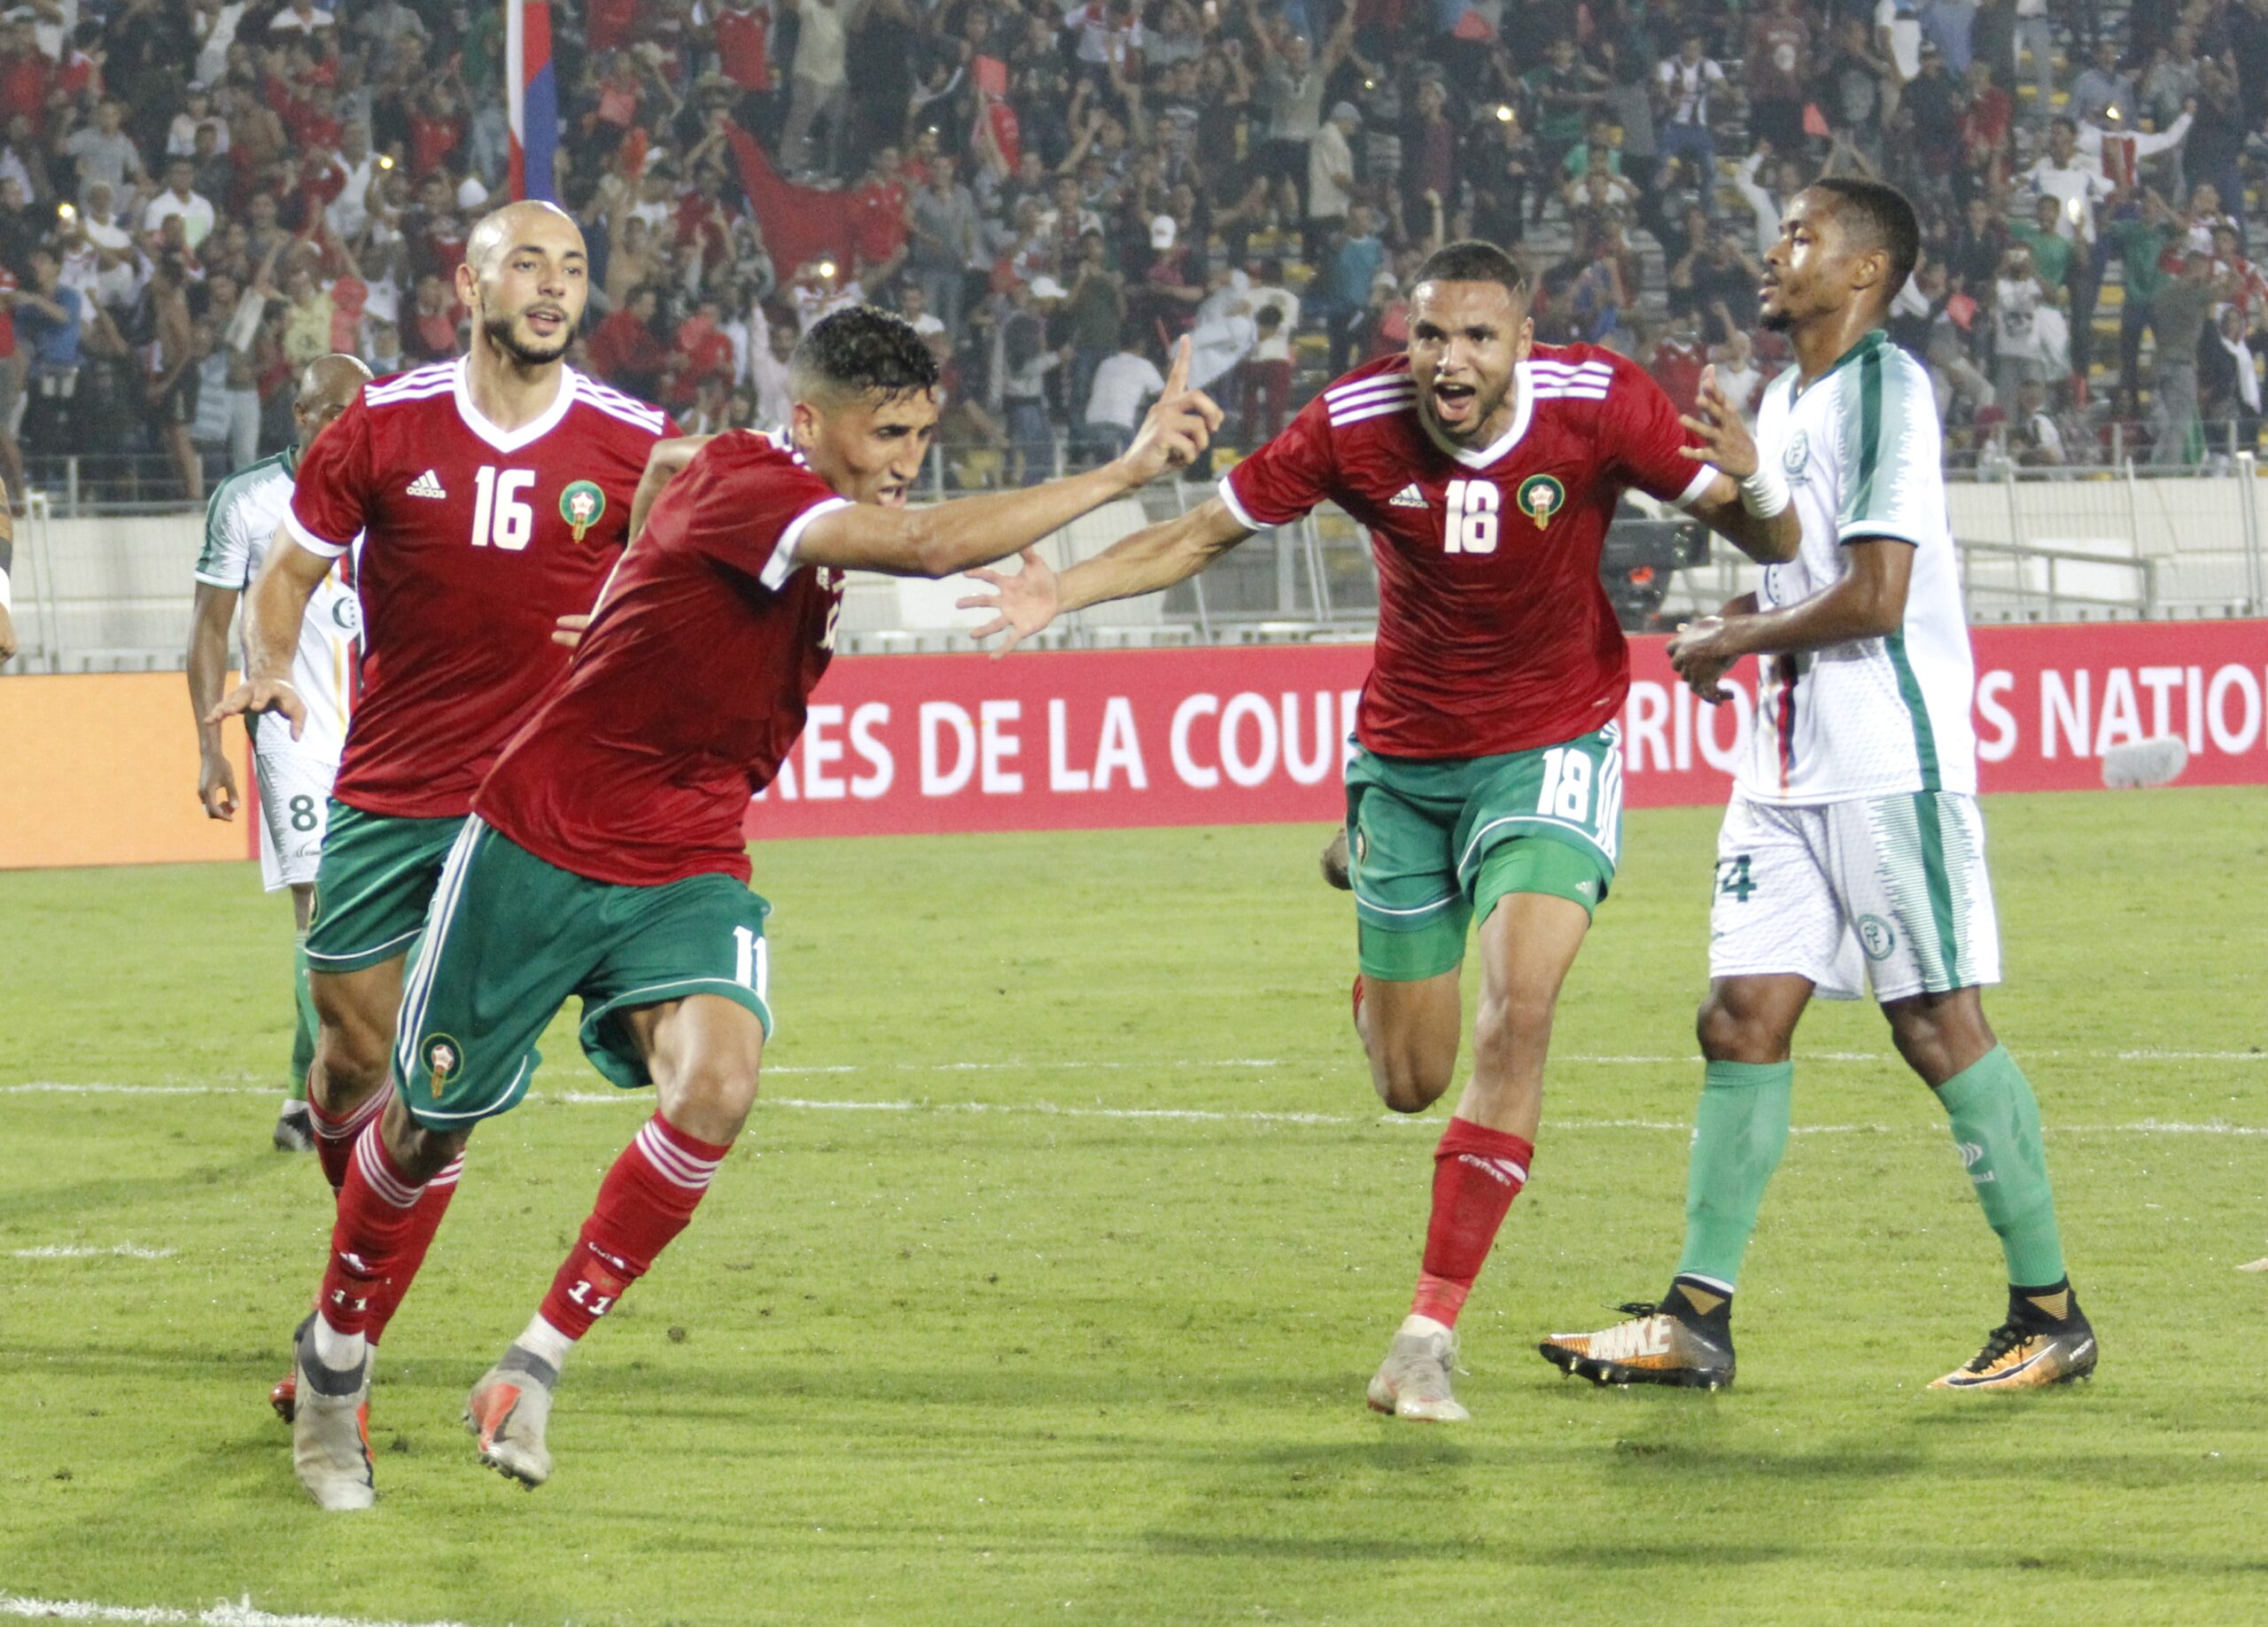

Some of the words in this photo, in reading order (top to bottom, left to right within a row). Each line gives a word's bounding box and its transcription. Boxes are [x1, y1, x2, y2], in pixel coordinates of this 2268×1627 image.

[406, 487, 447, 499] adidas
[471, 465, 535, 550] 16
[1444, 479, 1499, 553] 18
[920, 700, 1024, 797] DE
[1048, 697, 1148, 792] LA
[2040, 663, 2268, 759] NATIO
[289, 794, 318, 831] 8
[1536, 747, 1592, 823] 18
[733, 925, 767, 1001] 11
[568, 1280, 611, 1315] 11
